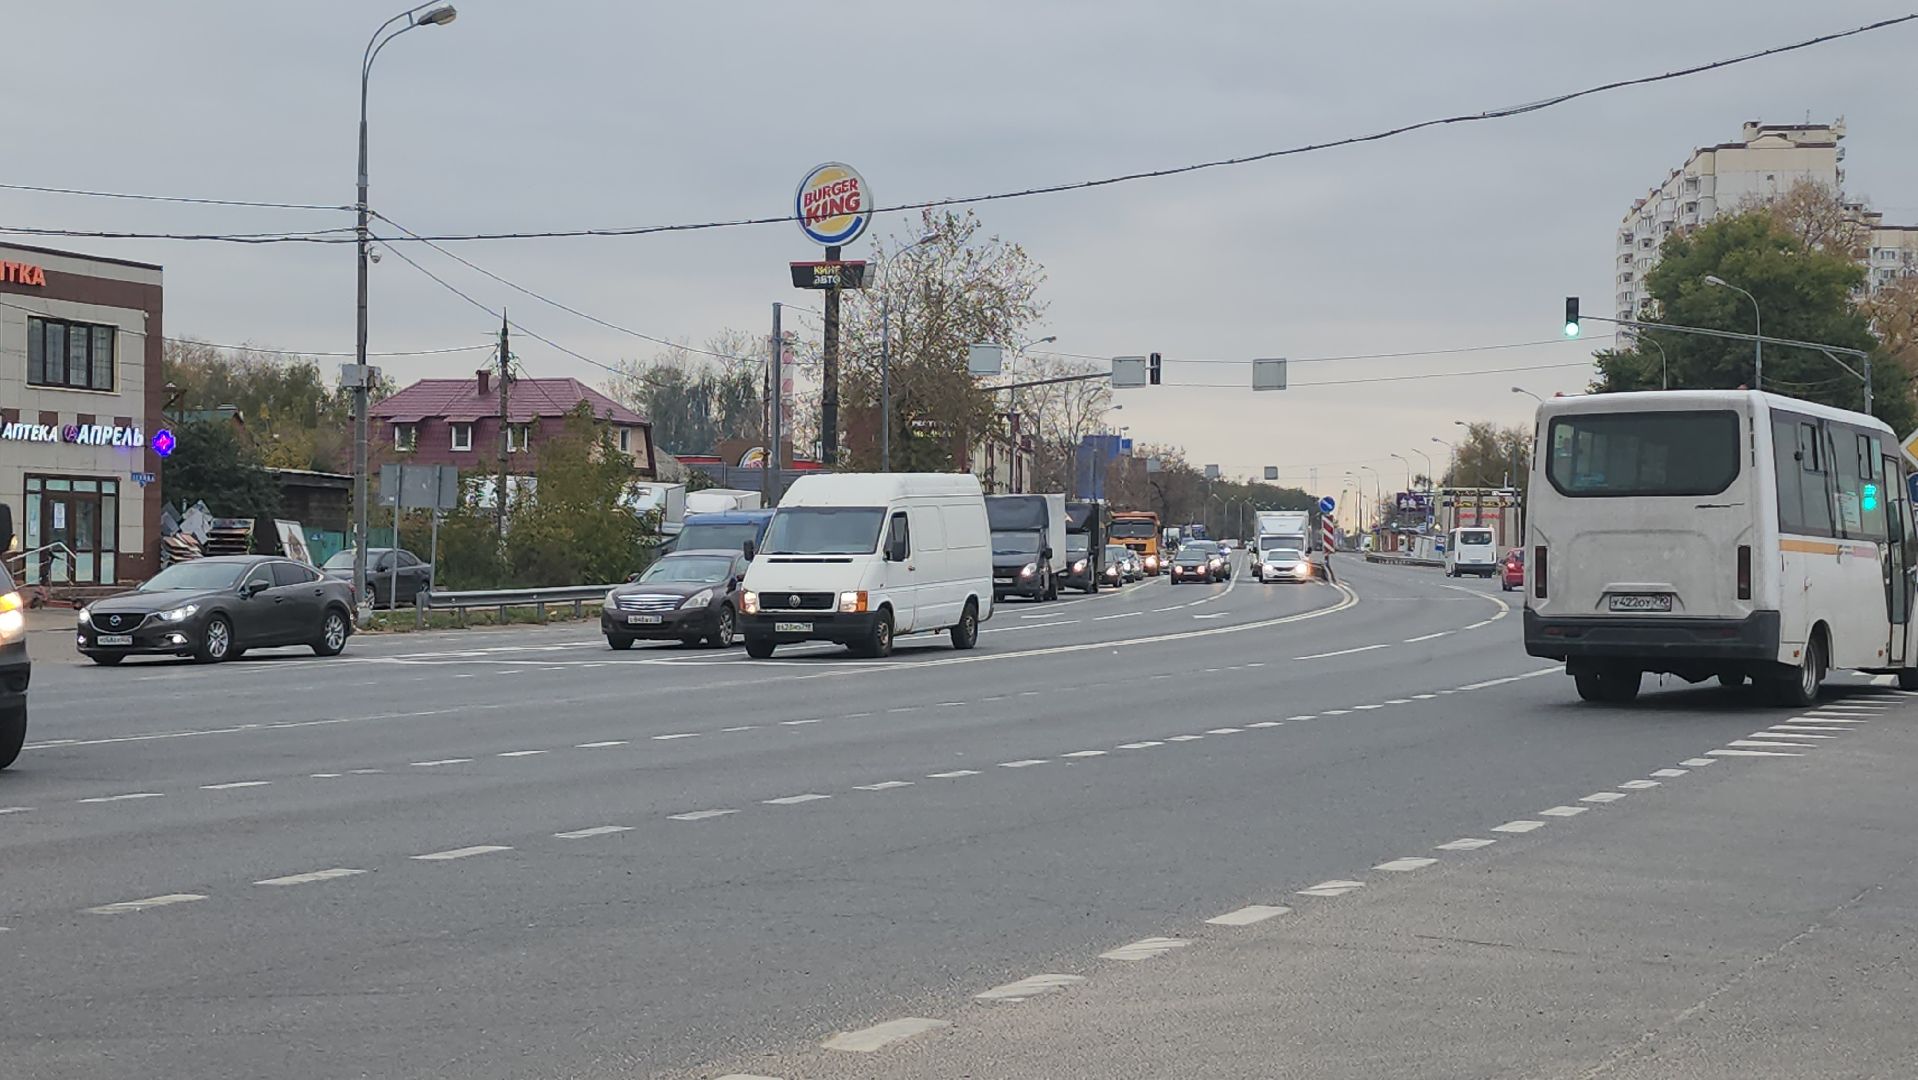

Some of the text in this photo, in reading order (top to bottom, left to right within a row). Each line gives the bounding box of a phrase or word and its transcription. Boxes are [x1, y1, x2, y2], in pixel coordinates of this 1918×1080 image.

[804, 178, 858, 208] BURGER
[805, 192, 861, 227] KING
[1, 422, 58, 442] АПТЕКА
[77, 424, 145, 447] АПРЕЛЬ
